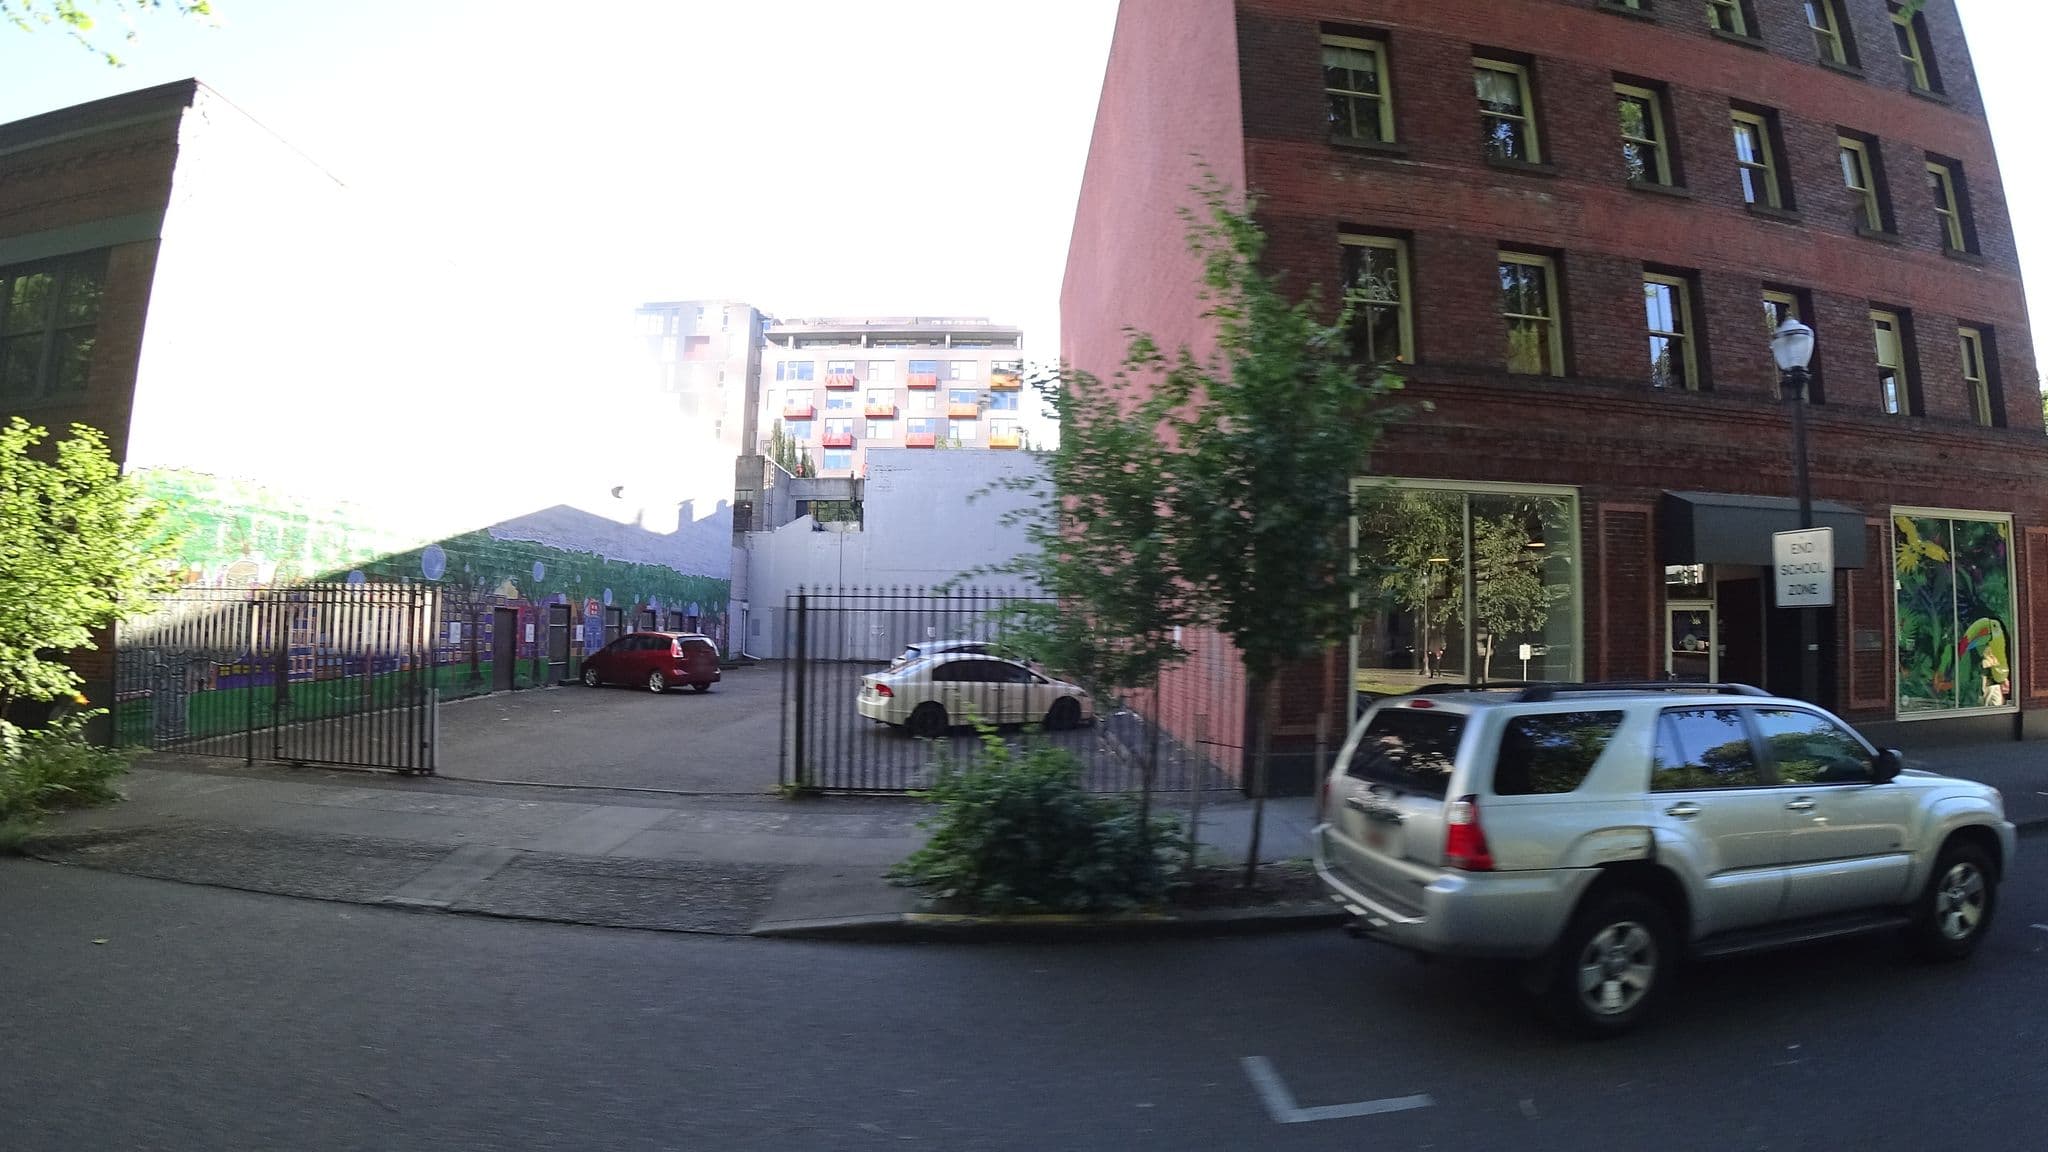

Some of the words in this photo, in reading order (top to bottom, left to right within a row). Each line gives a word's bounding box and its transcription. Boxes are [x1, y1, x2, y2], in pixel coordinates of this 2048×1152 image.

[1791, 542, 1814, 555] END
[1781, 562, 1827, 576] SCHOOL
[1788, 583, 1819, 596] ZONE
